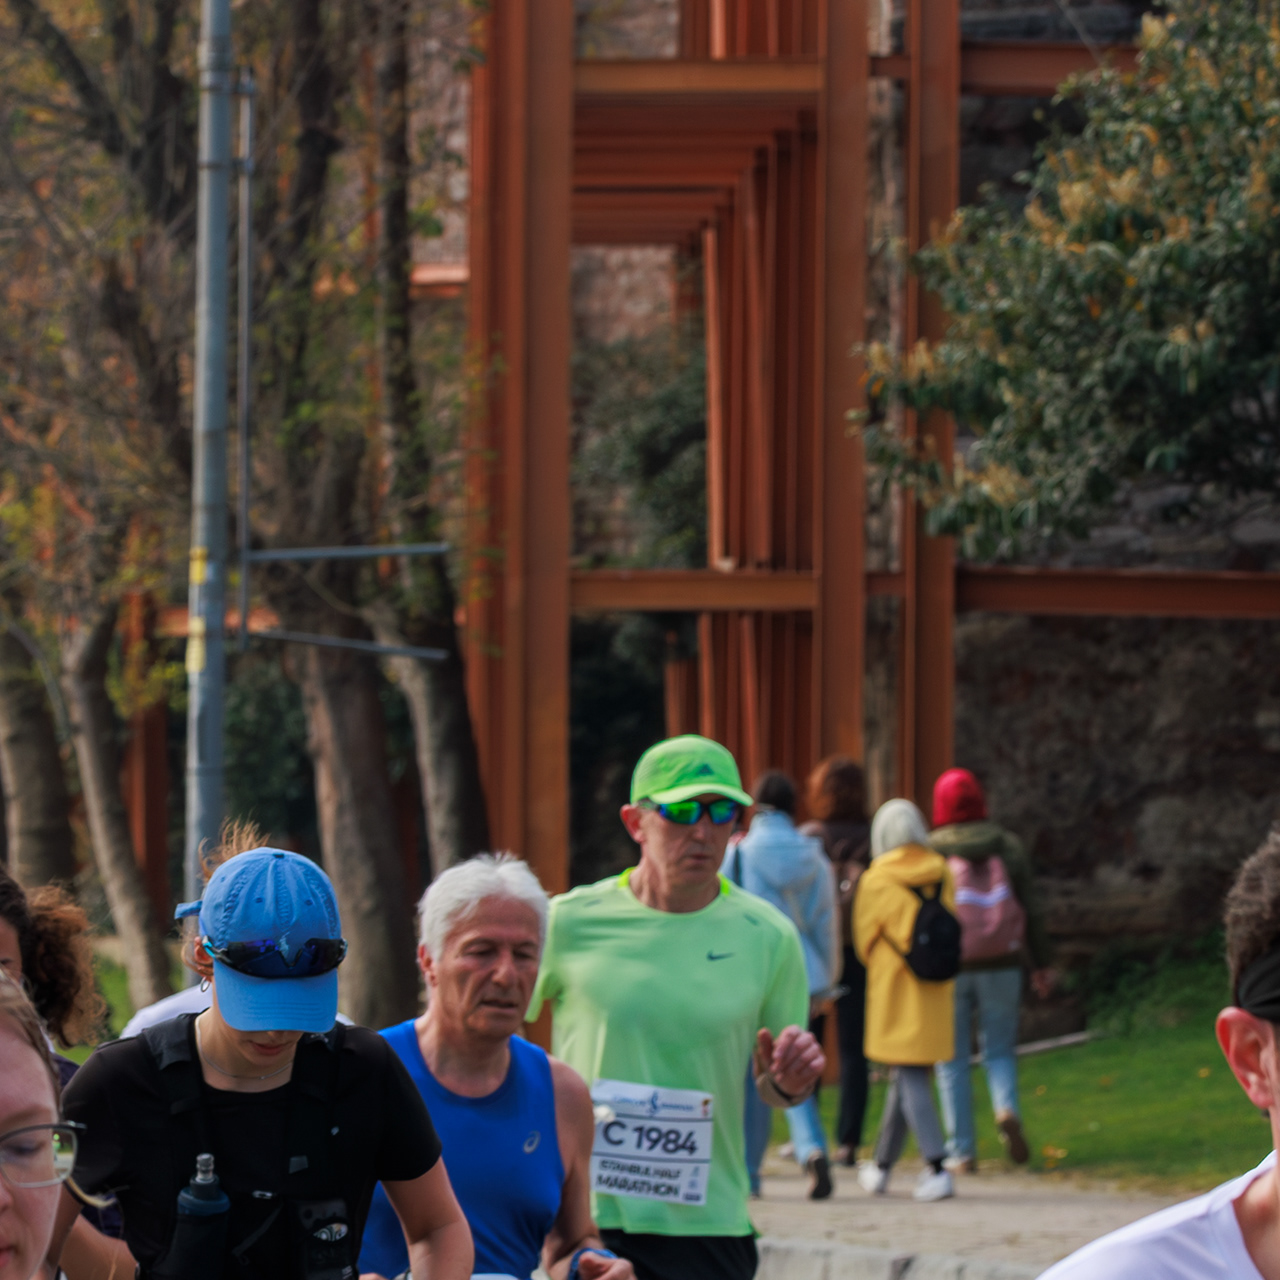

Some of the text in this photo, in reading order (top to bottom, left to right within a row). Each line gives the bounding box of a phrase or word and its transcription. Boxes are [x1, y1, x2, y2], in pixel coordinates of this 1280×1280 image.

[603, 1121, 698, 1155] C 1984
[596, 1174, 679, 1196] MARATHON
